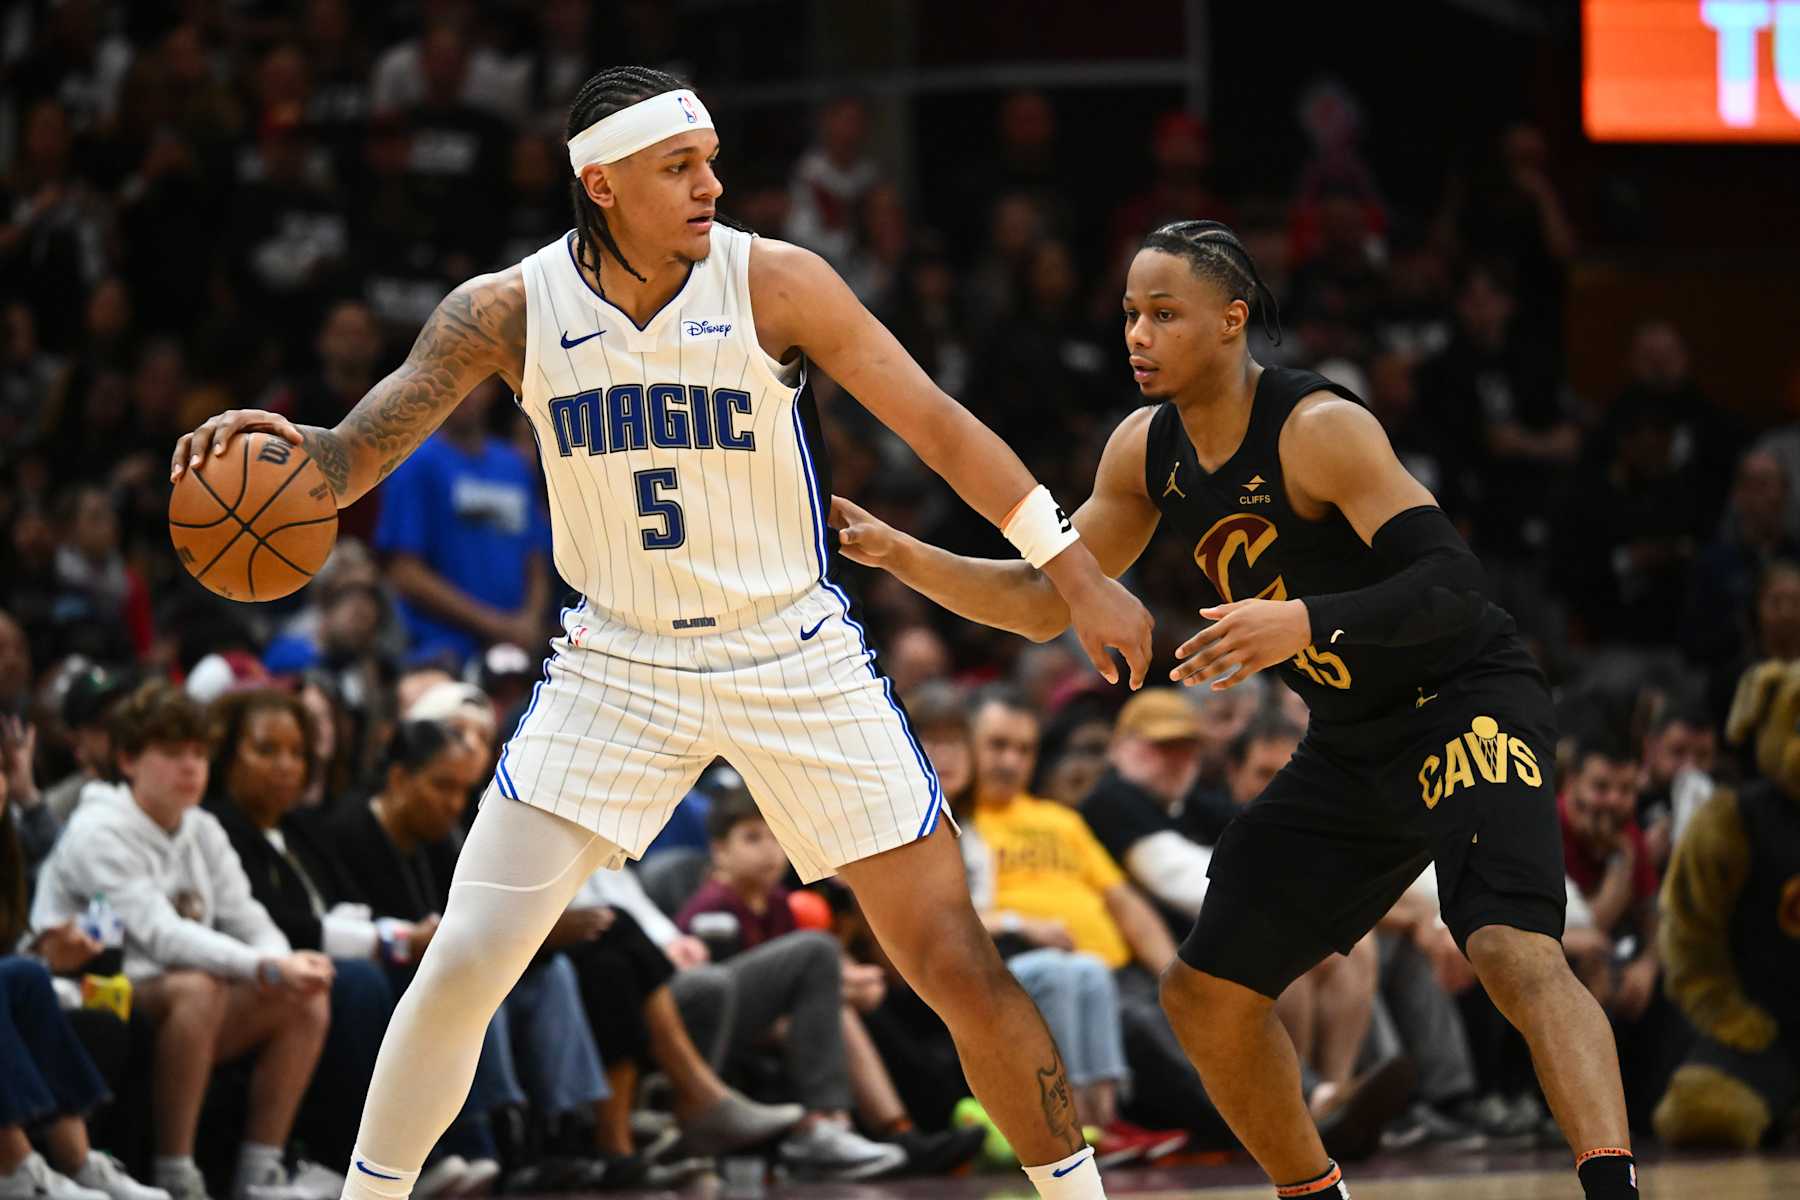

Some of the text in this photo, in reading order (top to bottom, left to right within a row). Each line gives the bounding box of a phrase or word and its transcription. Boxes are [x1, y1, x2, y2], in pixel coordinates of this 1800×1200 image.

[548, 383, 756, 457] MAGIC
[634, 467, 686, 551] 5
[1239, 494, 1271, 505] CLIFFS
[1417, 728, 1544, 811] CAVS
